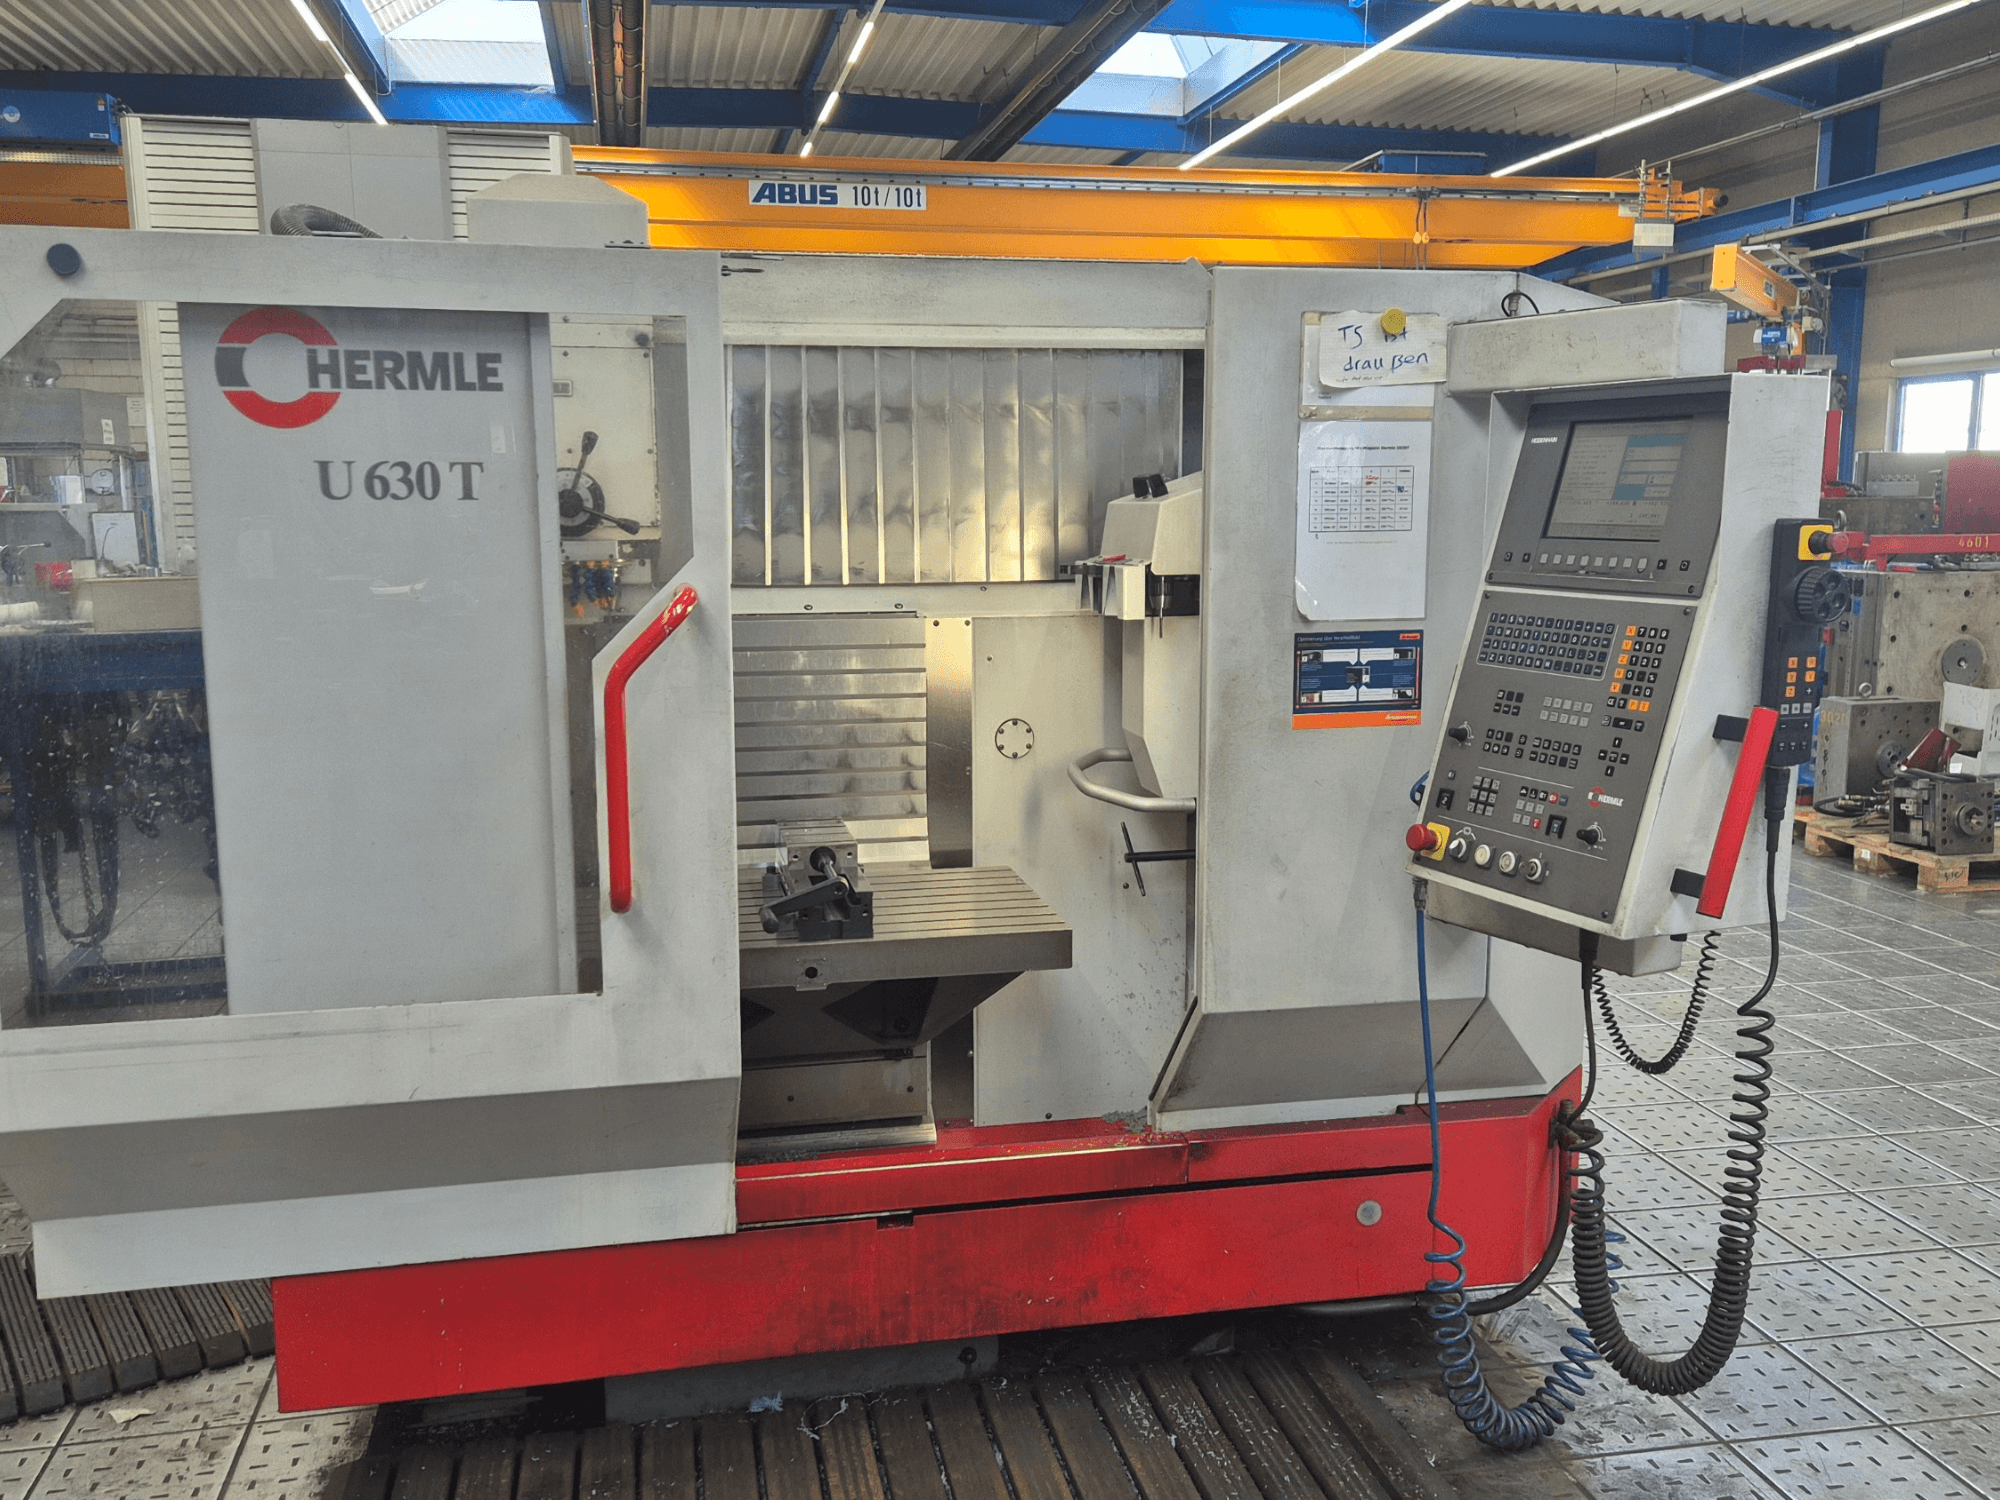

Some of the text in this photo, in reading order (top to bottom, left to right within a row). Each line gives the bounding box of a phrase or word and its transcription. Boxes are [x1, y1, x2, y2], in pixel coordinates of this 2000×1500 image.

[751, 182, 839, 206] ABUS
[1337, 325, 1363, 349] TS
[306, 348, 504, 392] HERMLE
[313, 460, 484, 501] U 630 T
[1958, 536, 1989, 548] 4601
